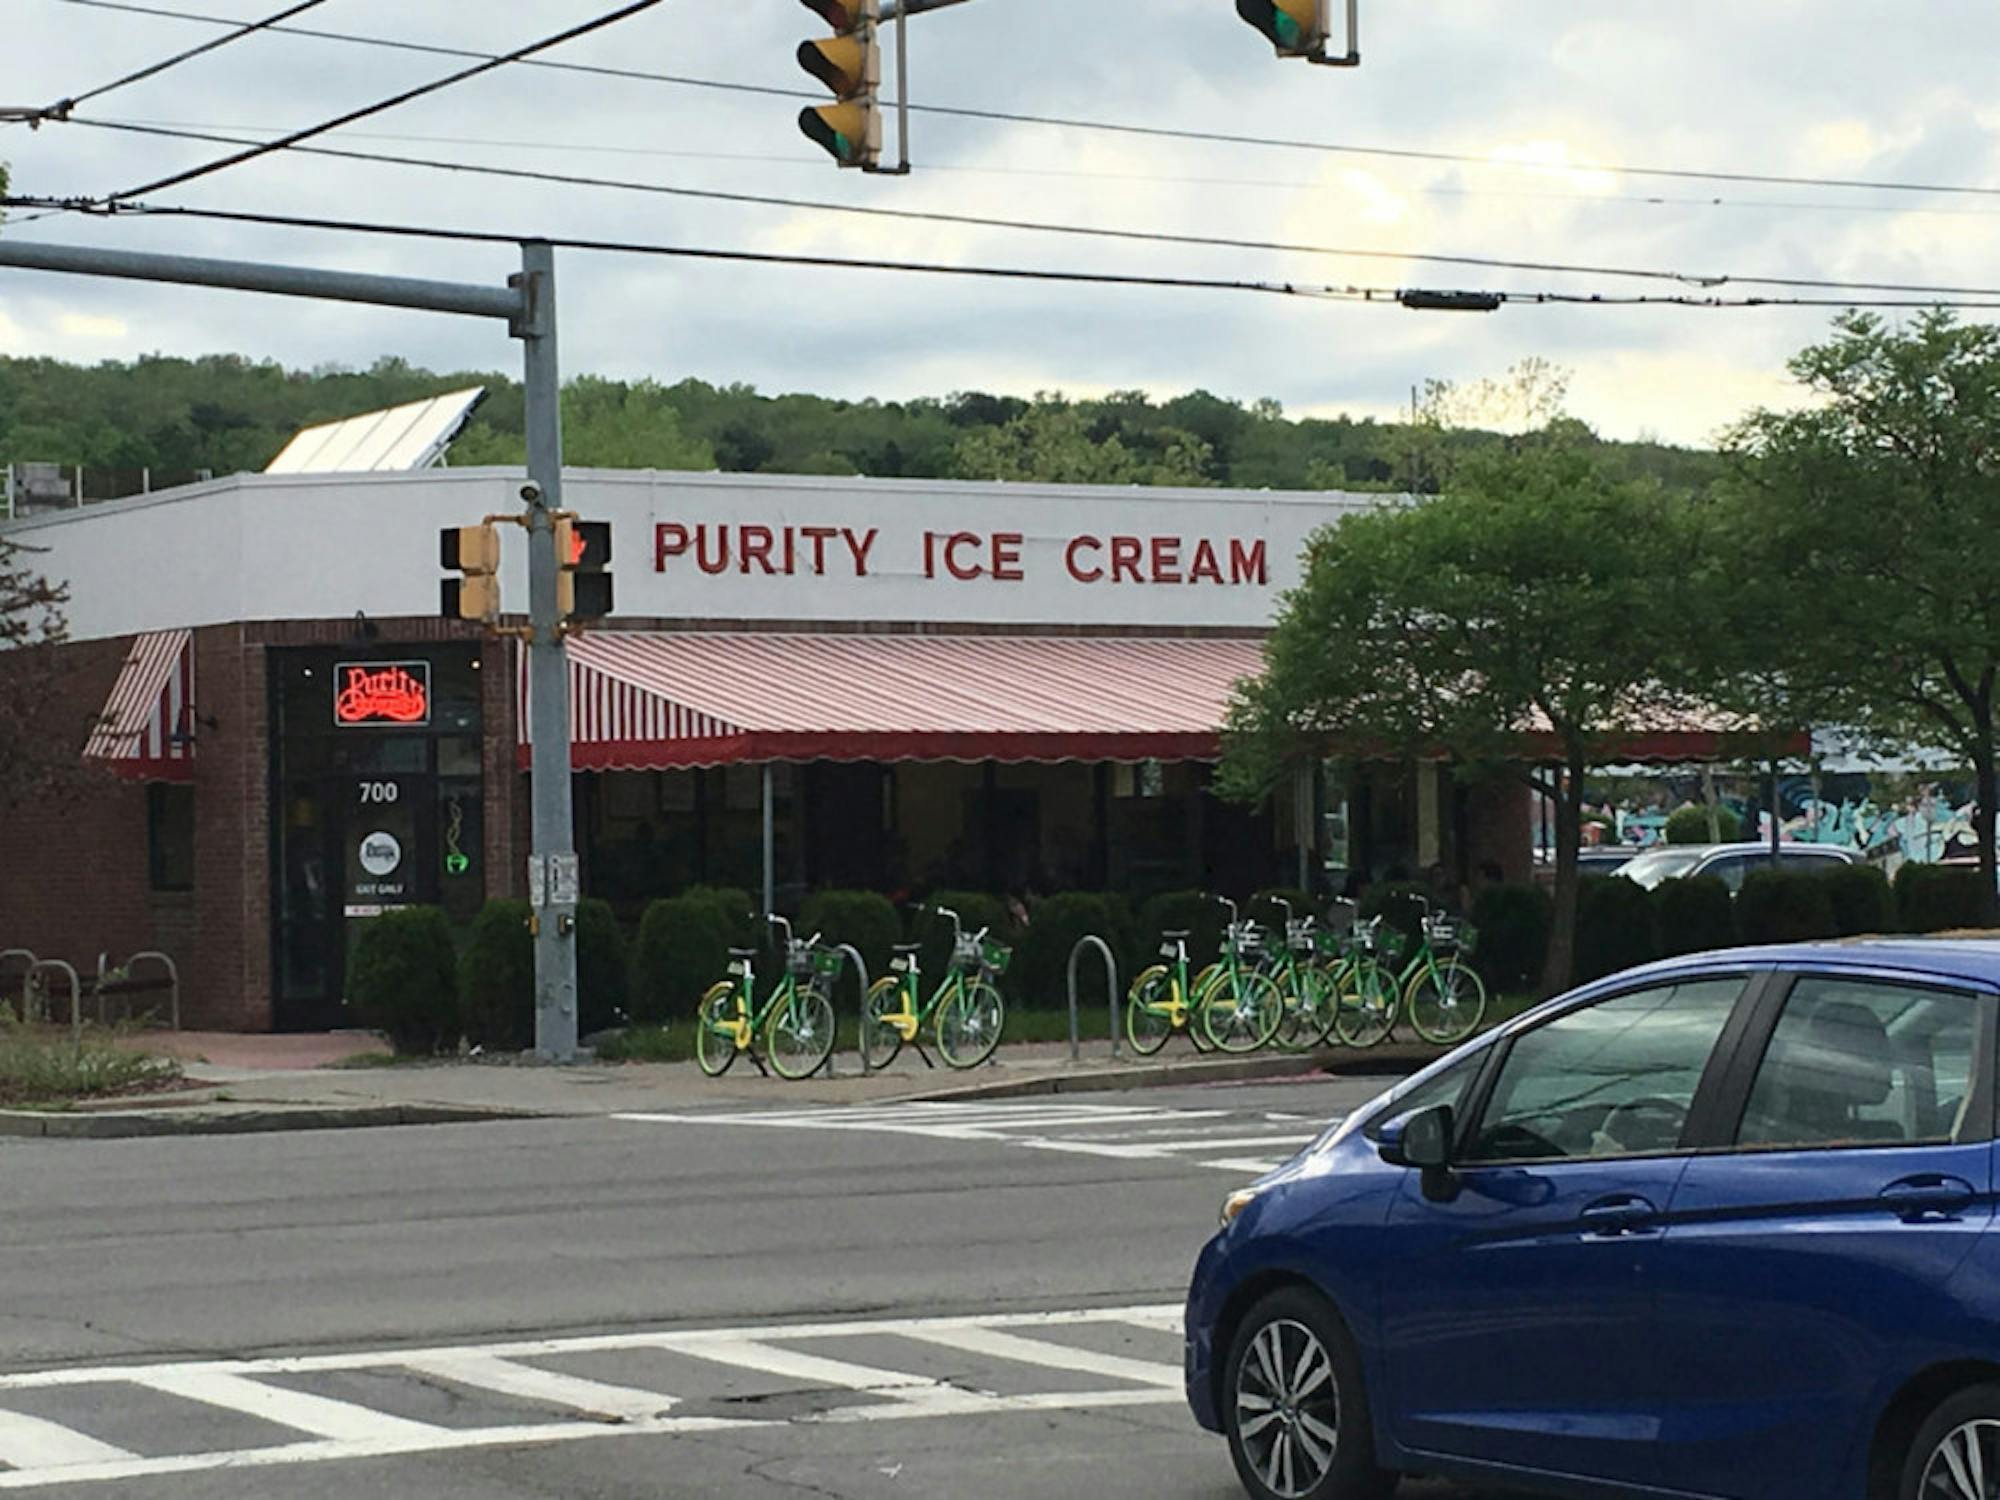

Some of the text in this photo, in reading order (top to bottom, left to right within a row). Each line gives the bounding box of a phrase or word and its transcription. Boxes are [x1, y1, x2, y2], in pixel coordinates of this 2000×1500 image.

[655, 522, 1267, 585] PURITY ICE CREAM
[360, 782, 399, 804] 700
